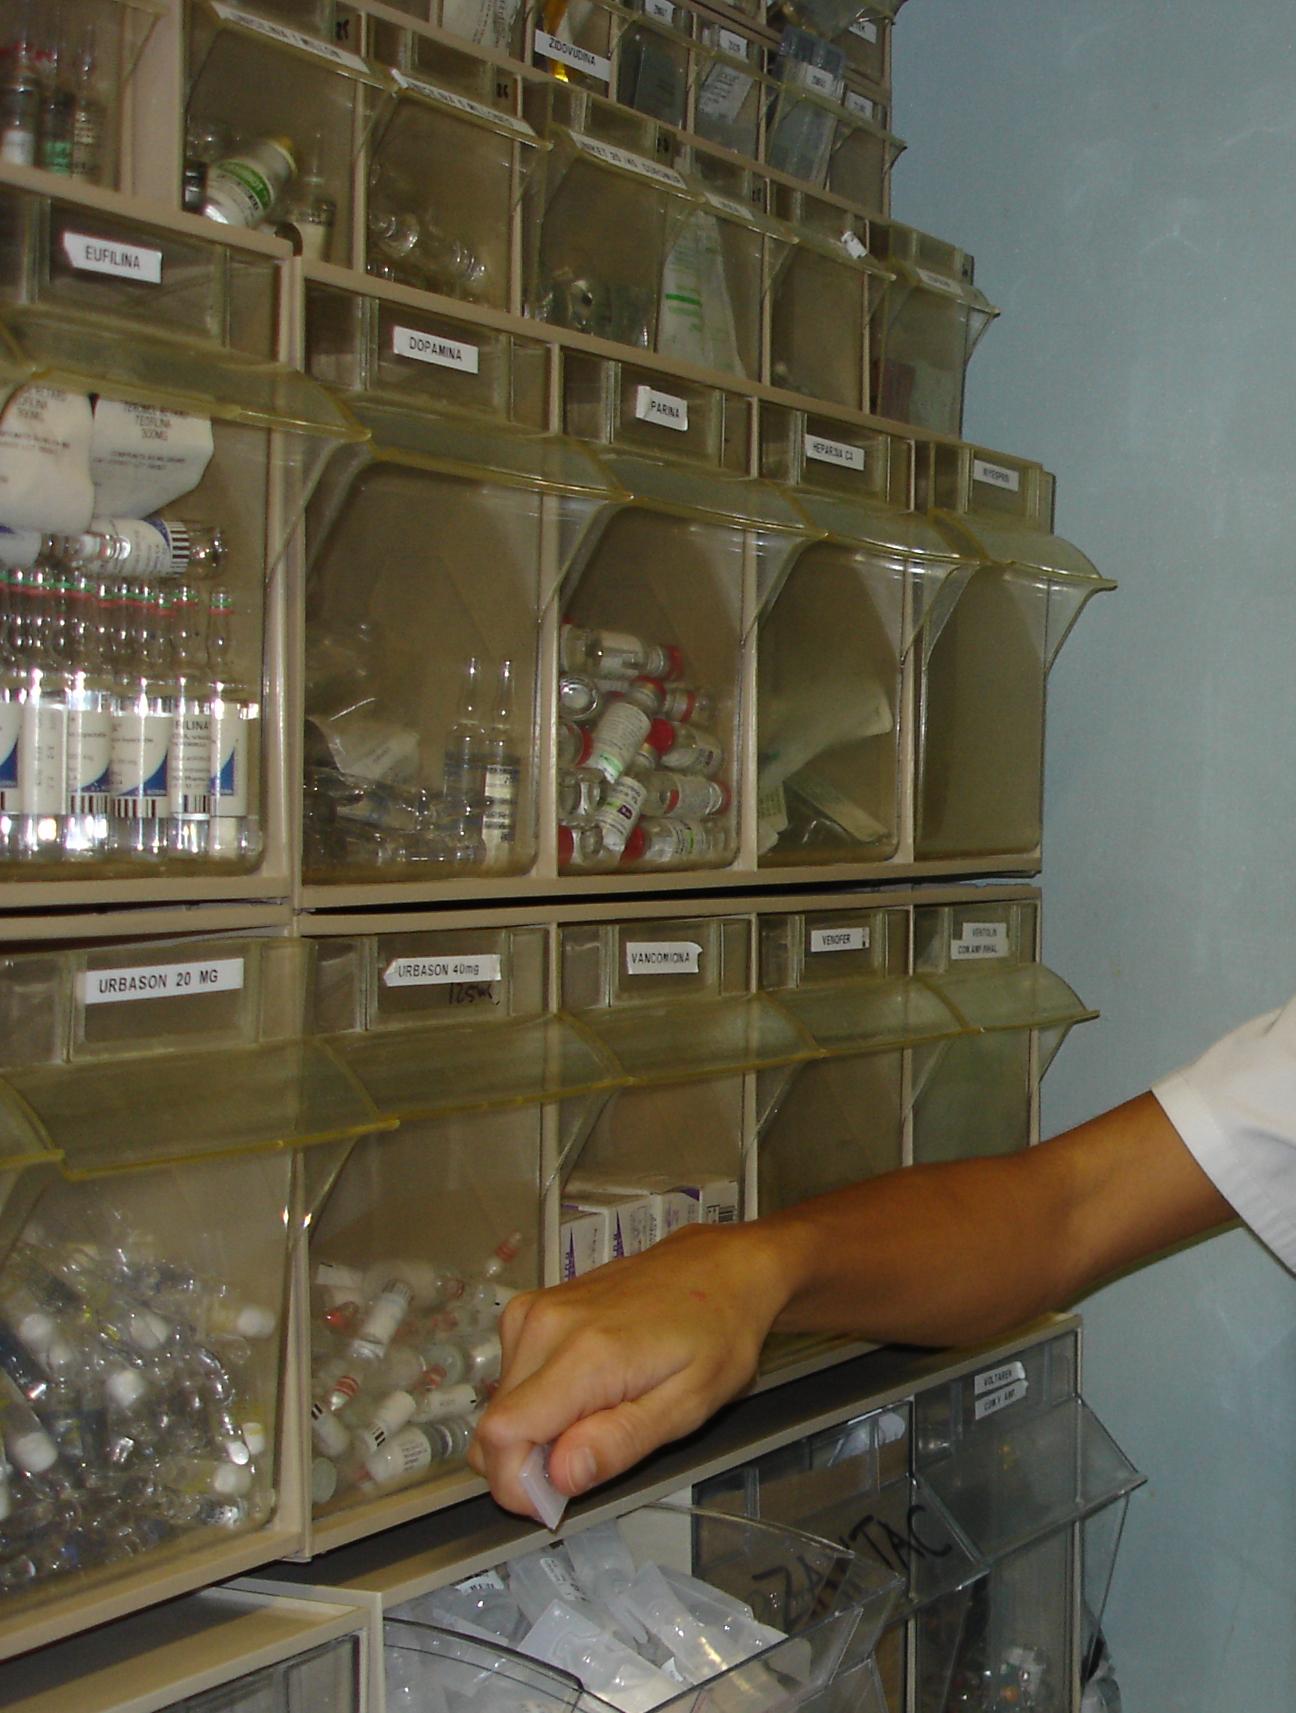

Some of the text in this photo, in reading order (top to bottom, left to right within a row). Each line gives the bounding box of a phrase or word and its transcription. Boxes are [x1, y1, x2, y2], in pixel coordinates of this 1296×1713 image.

[548, 37, 597, 67] ZIDOVUDINA
[85, 244, 141, 271] EUFILINA
[408, 336, 463, 361] DOPAMINA
[99, 968, 219, 994] URBASON 20 MG
[398, 963, 480, 978] URBASON 40mg
